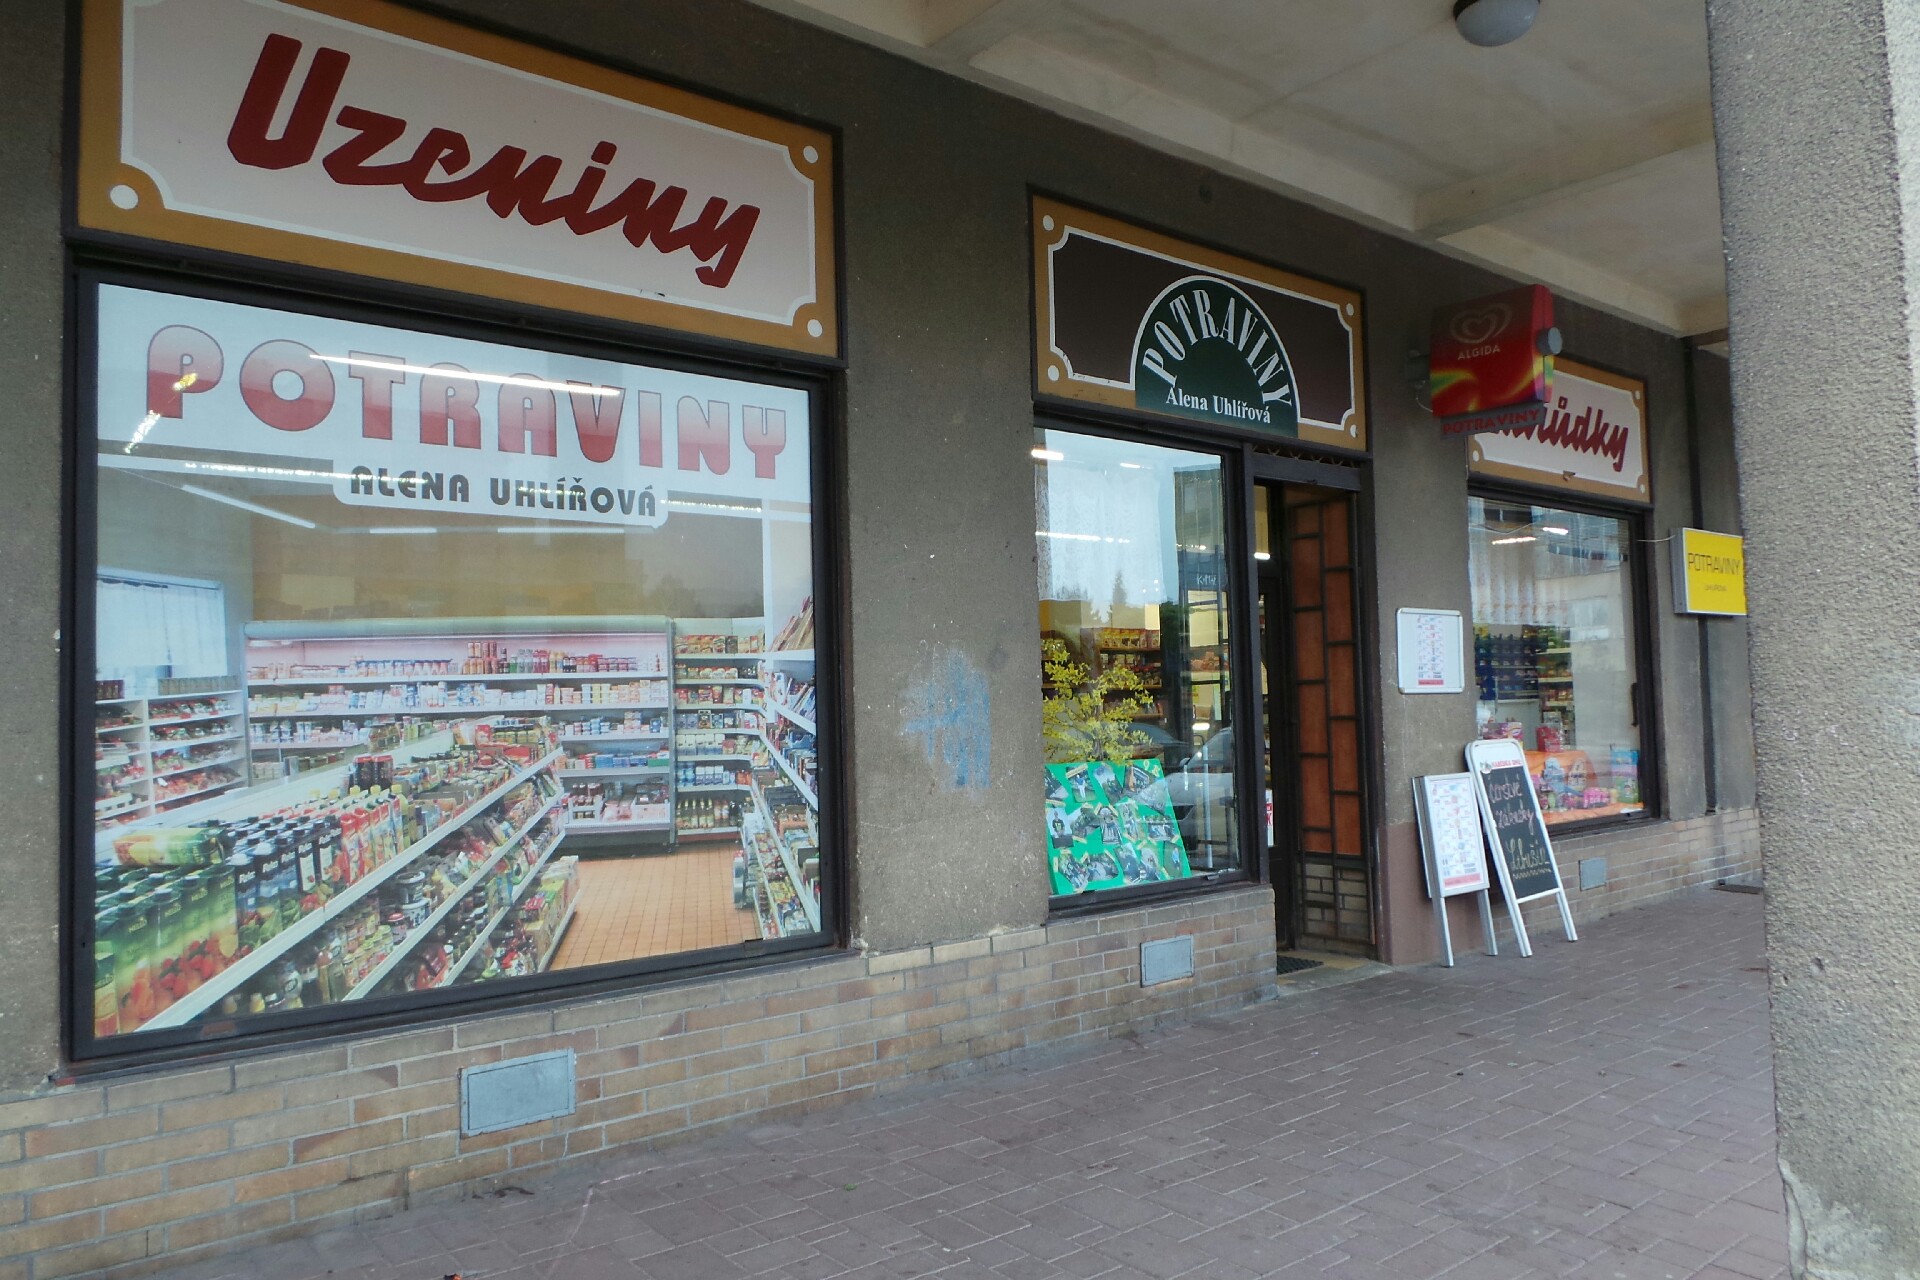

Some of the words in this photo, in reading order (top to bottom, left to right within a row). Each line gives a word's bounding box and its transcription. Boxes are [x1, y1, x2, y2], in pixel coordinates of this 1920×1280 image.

[227, 33, 760, 288] Uzeniny
[1142, 289, 1292, 406] POTRAVINY
[1457, 344, 1500, 361] ALGIDA
[146, 325, 787, 480] POTRAVINY
[1165, 386, 1209, 411] Alena
[1213, 395, 1271, 424] Uhlířová
[1443, 408, 1539, 435] POTRAVINY
[350, 465, 470, 503] ALENA
[490, 476, 657, 517] UHLÍŘOVÁ
[1688, 552, 1740, 575] POTRAVINY
